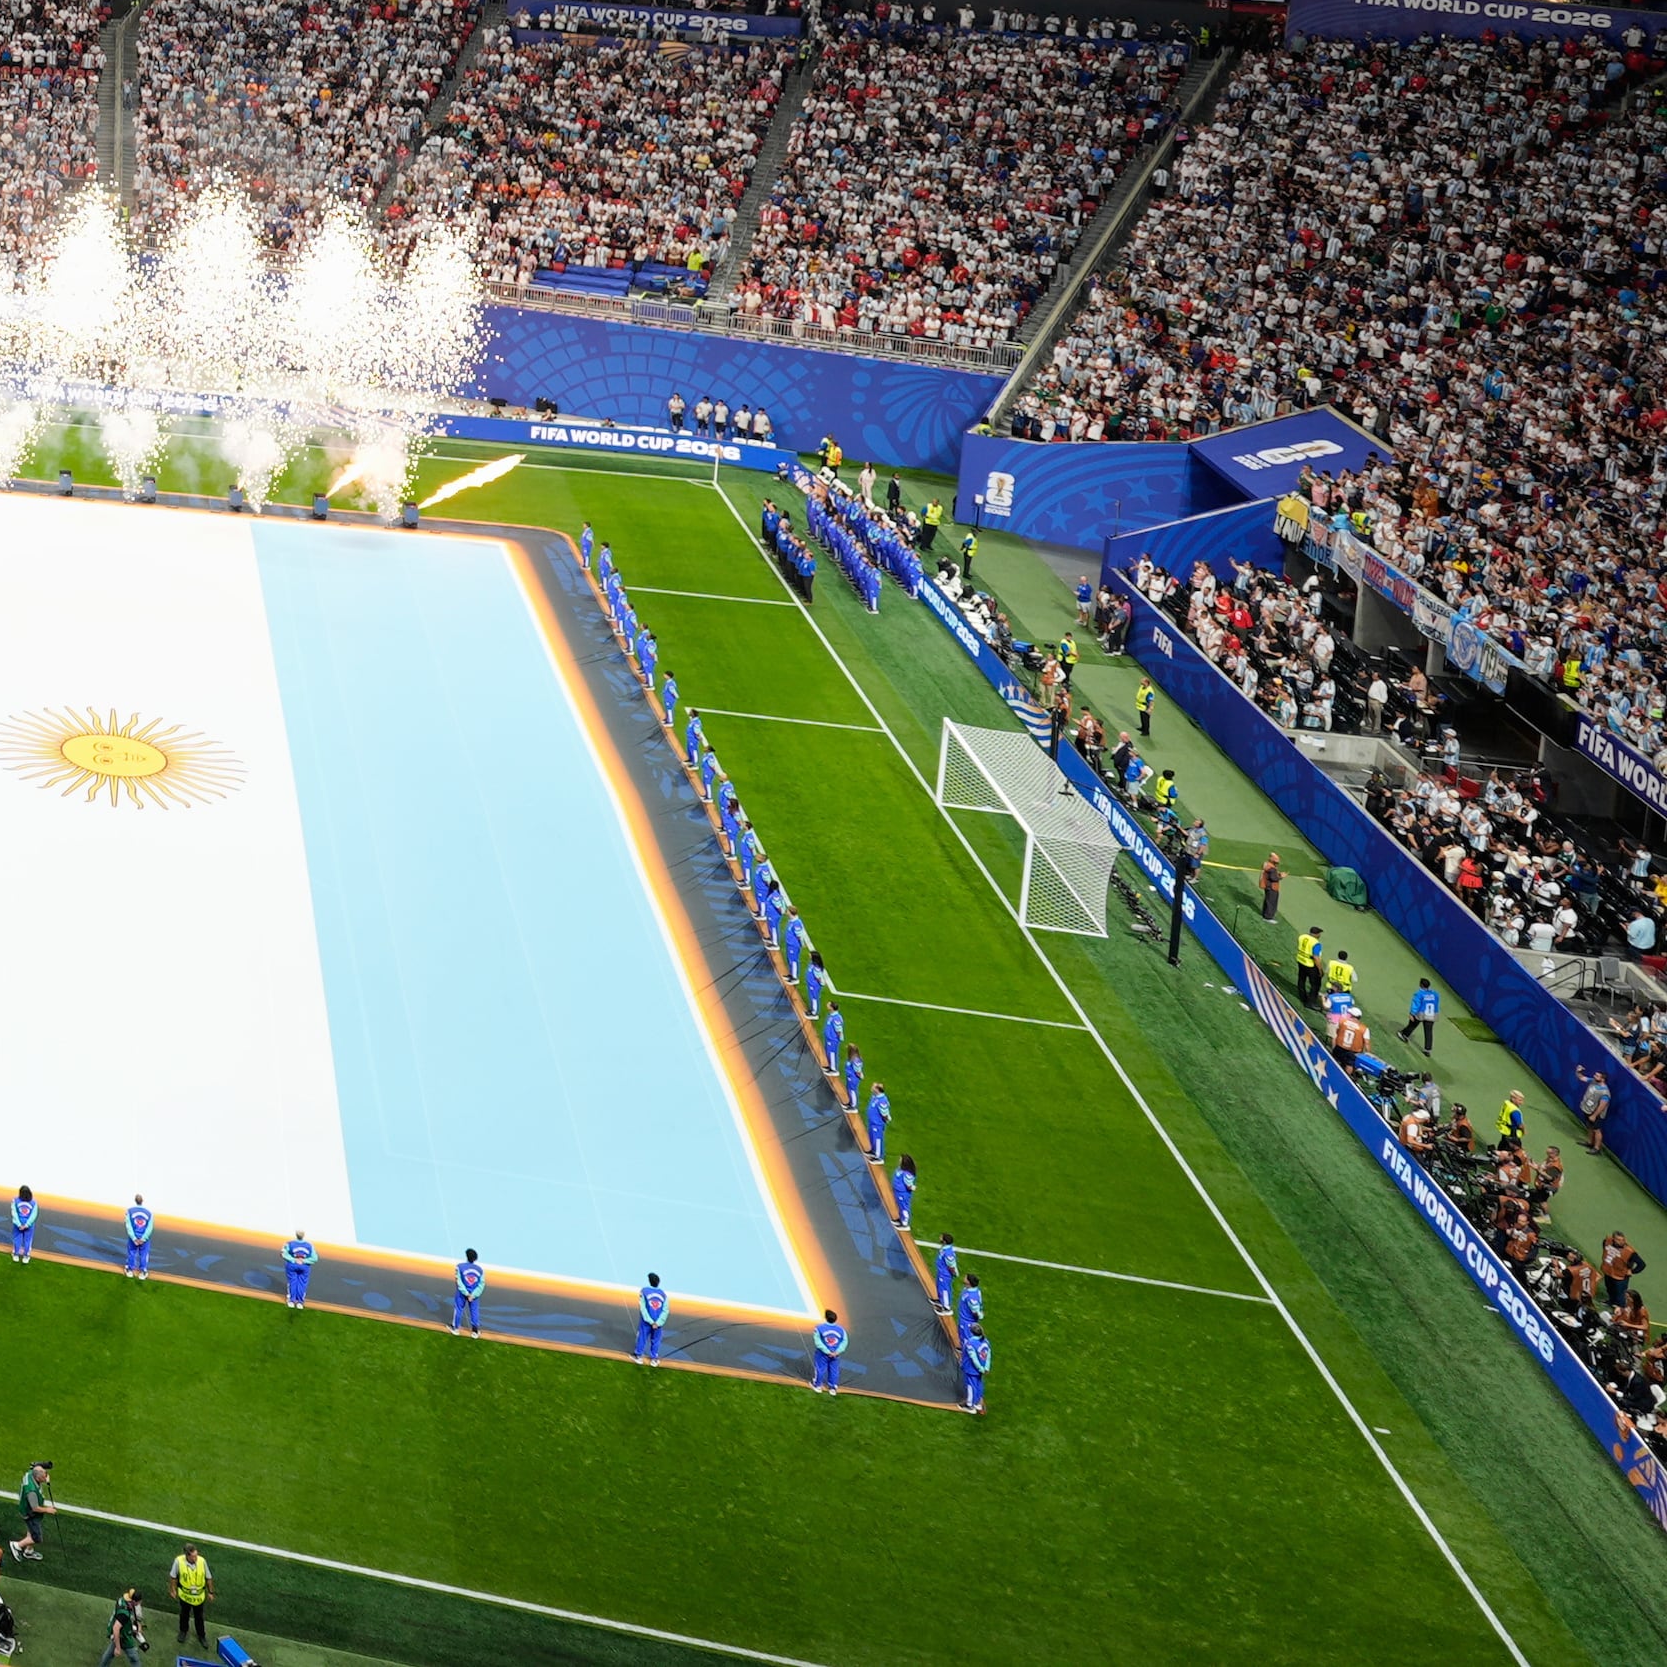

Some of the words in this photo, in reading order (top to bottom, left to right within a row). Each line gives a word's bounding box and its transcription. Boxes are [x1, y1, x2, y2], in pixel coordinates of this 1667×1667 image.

[1483, 2, 1528, 21] CUP
[1531, 7, 1612, 29] 2026
[530, 426, 569, 443] FIFA
[570, 429, 636, 448] WORLD
[637, 435, 674, 451] CUP
[675, 439, 742, 461] 2026
[1152, 626, 1173, 659] FIFA
[1578, 721, 1616, 771] FIFA
[1112, 807, 1144, 856] WORLD
[1142, 847, 1163, 877] CUP
[1382, 1137, 1413, 1190] FIFA
[1413, 1174, 1466, 1251] WORLD
[1466, 1241, 1499, 1288] CUP
[1498, 1281, 1555, 1364] 2026
